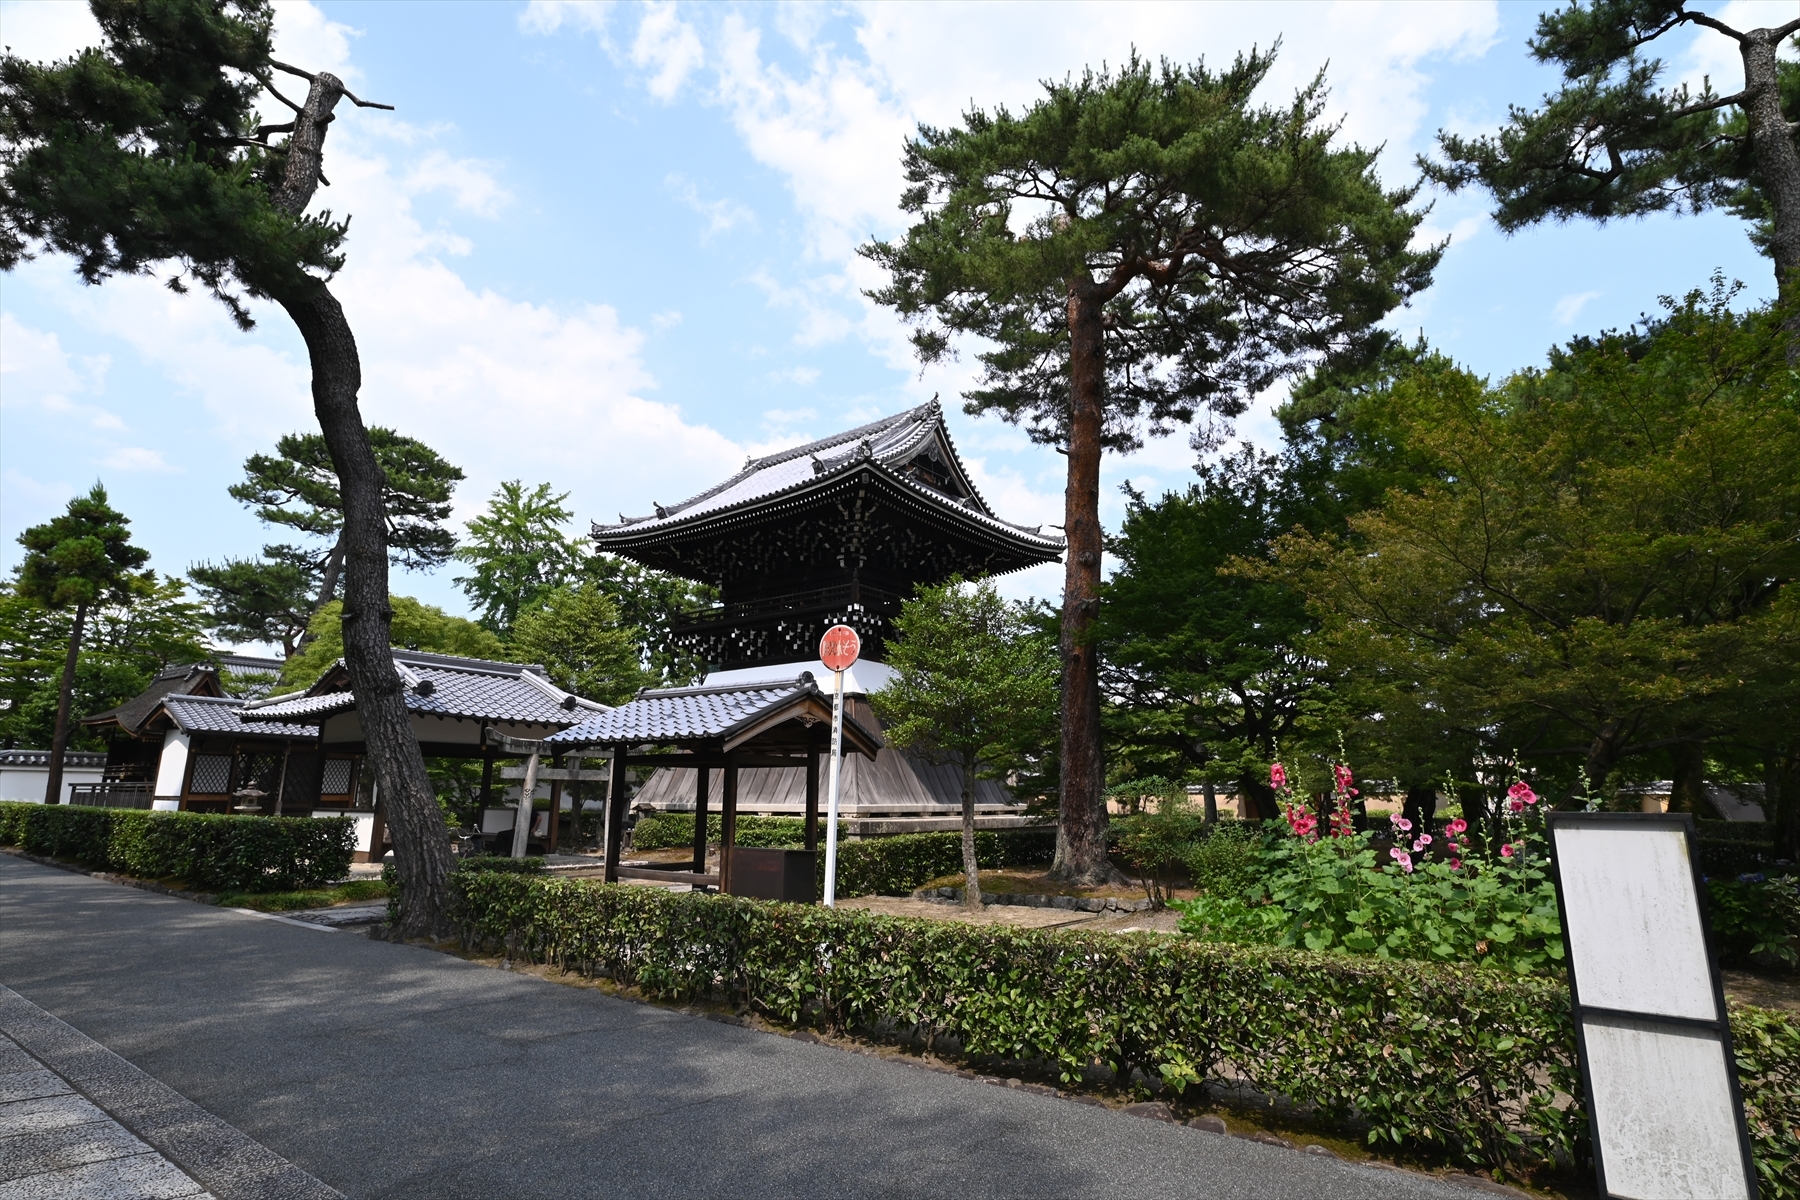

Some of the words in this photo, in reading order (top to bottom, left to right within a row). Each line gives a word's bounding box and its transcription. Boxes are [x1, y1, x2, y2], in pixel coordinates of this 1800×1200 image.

[831, 689, 840, 758] 京都市消防局
